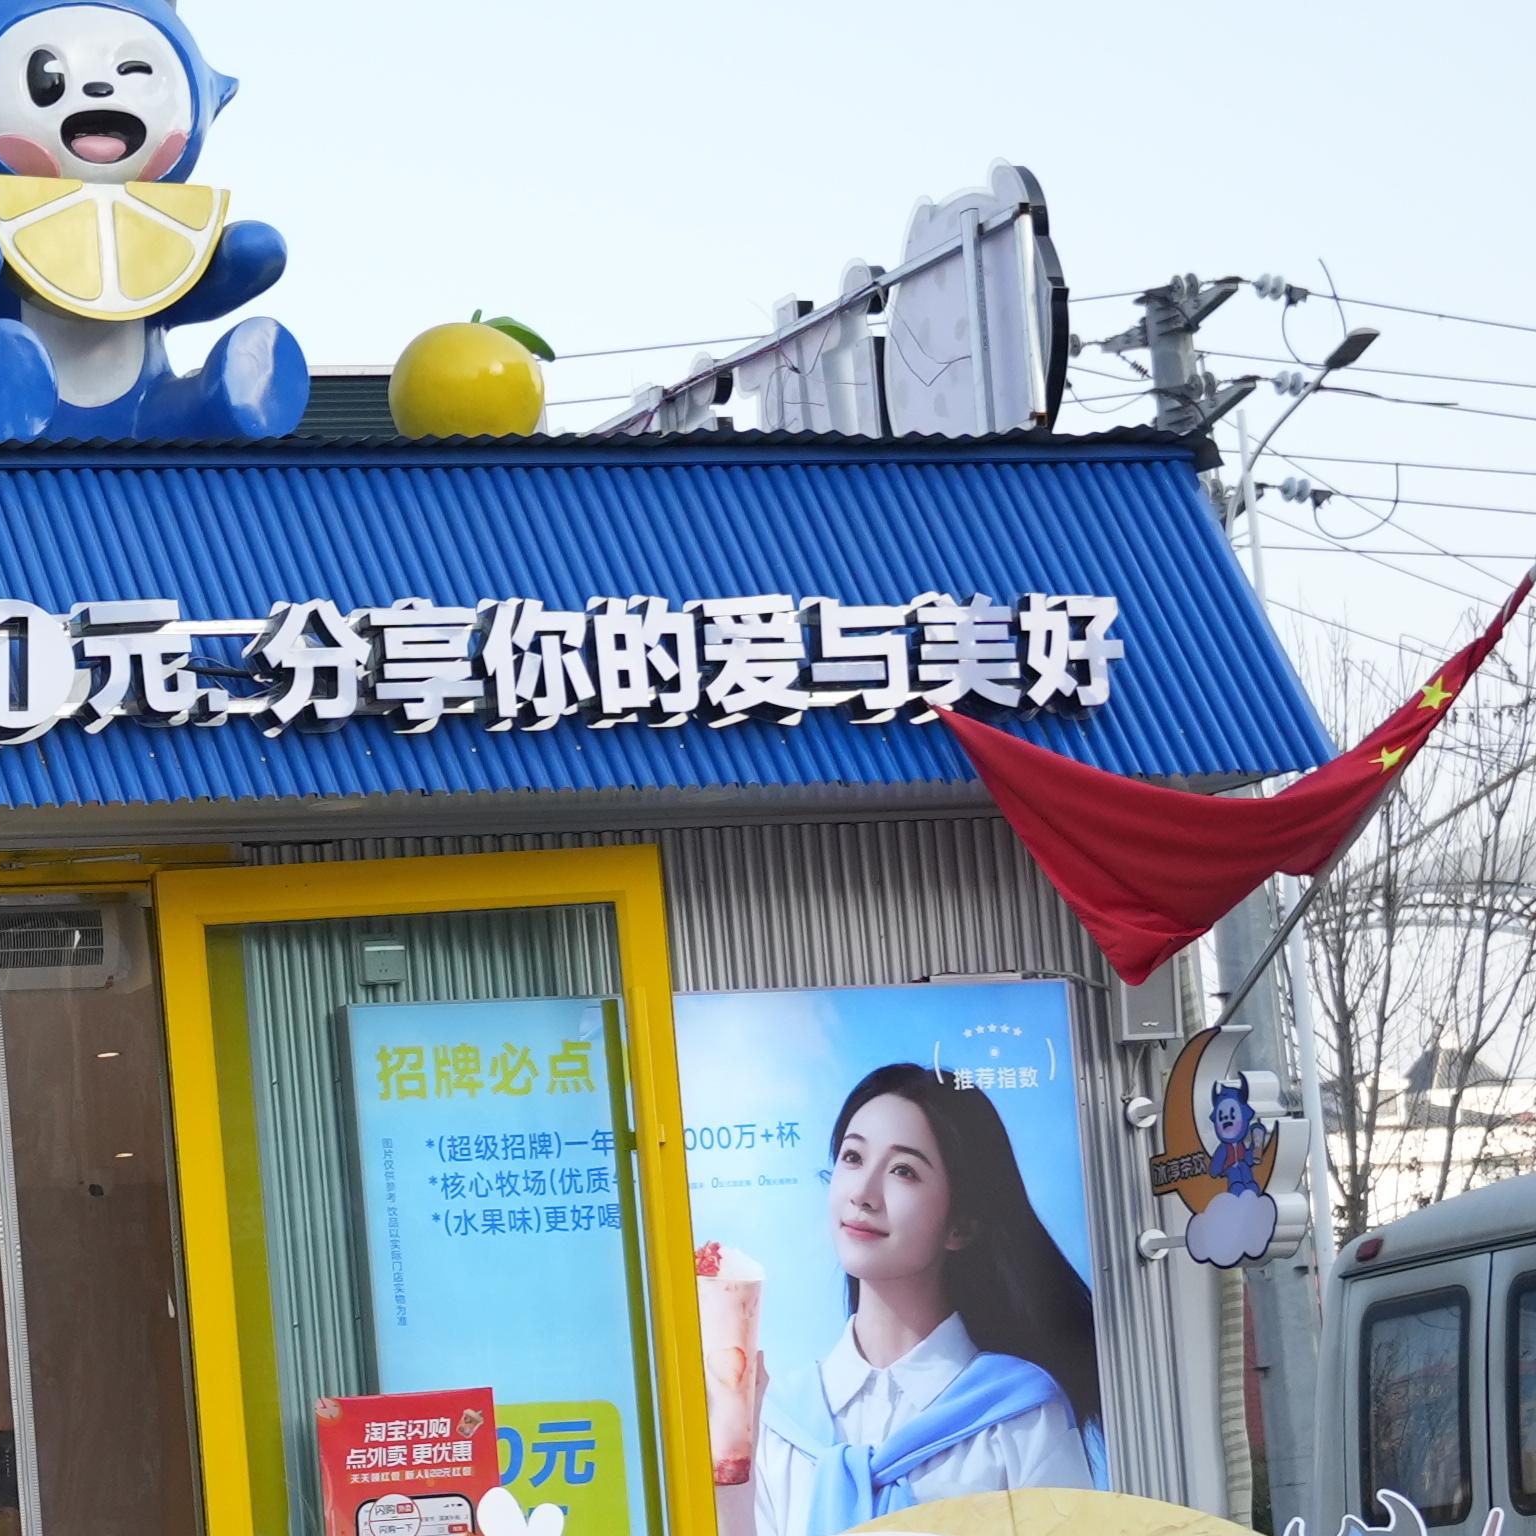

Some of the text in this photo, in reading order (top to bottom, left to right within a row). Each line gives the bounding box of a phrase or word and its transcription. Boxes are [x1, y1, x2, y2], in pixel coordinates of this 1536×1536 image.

[375, 1039, 595, 1100] 招牌必点
[953, 1067, 1039, 1091] 推荐指数
[364, 1417, 451, 1443] 淘宝闪购
[346, 1440, 472, 1469] 点外卖 更优惠
